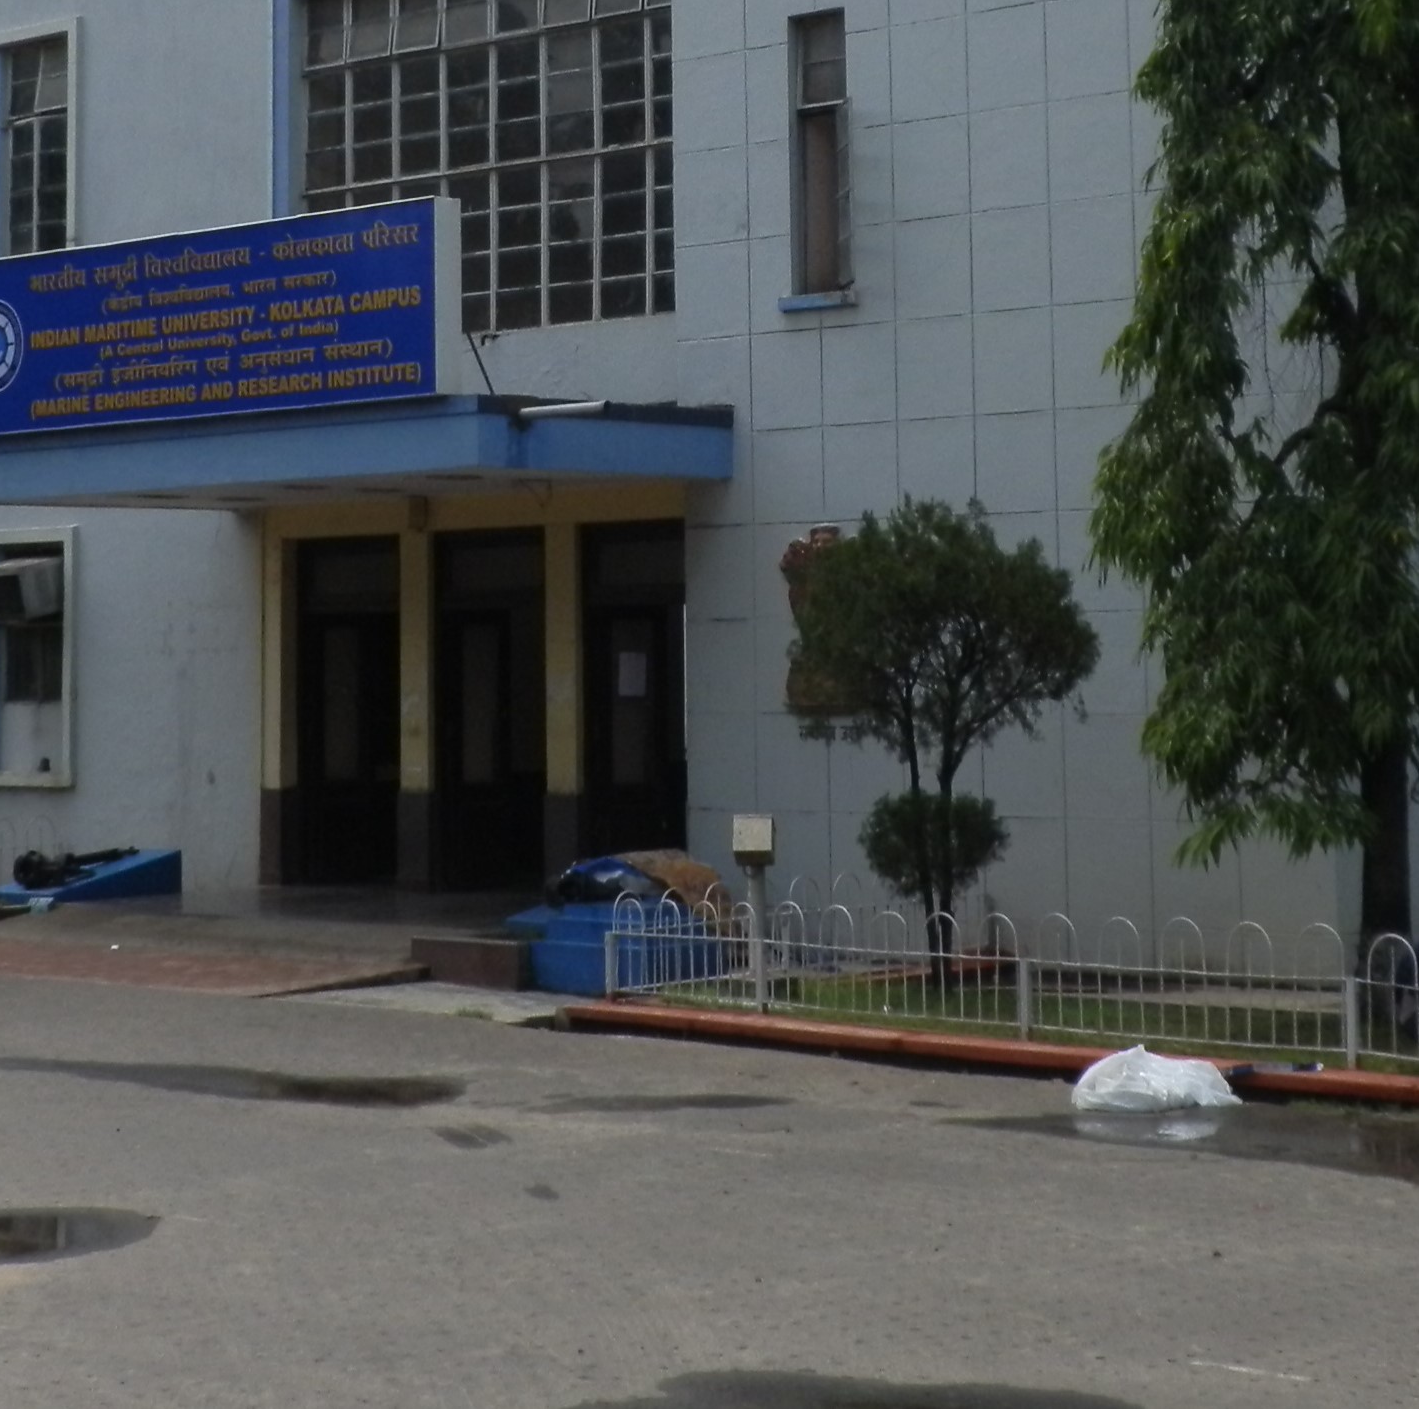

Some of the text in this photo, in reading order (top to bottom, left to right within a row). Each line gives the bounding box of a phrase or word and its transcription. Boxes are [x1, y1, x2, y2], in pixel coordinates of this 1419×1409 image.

[30, 263, 86, 291] भारतीय
[272, 233, 354, 261] कोलकाता
[361, 219, 420, 249] परिसर
[31, 326, 80, 350] INDIAN
[84, 317, 157, 343] MARITIME
[162, 305, 256, 335] UNIVERSITY
[269, 294, 345, 321] KOLKATA
[350, 285, 421, 312] CAMPUS
[117, 339, 163, 357] Central
[241, 326, 275, 342] Govt.
[281, 324, 294, 338] of
[299, 319, 339, 335] India)
[31, 362, 421, 421] (MARINE ENGINEERING AND RESEARCH INSTITUTE)
[206, 351, 229, 376] एवं
